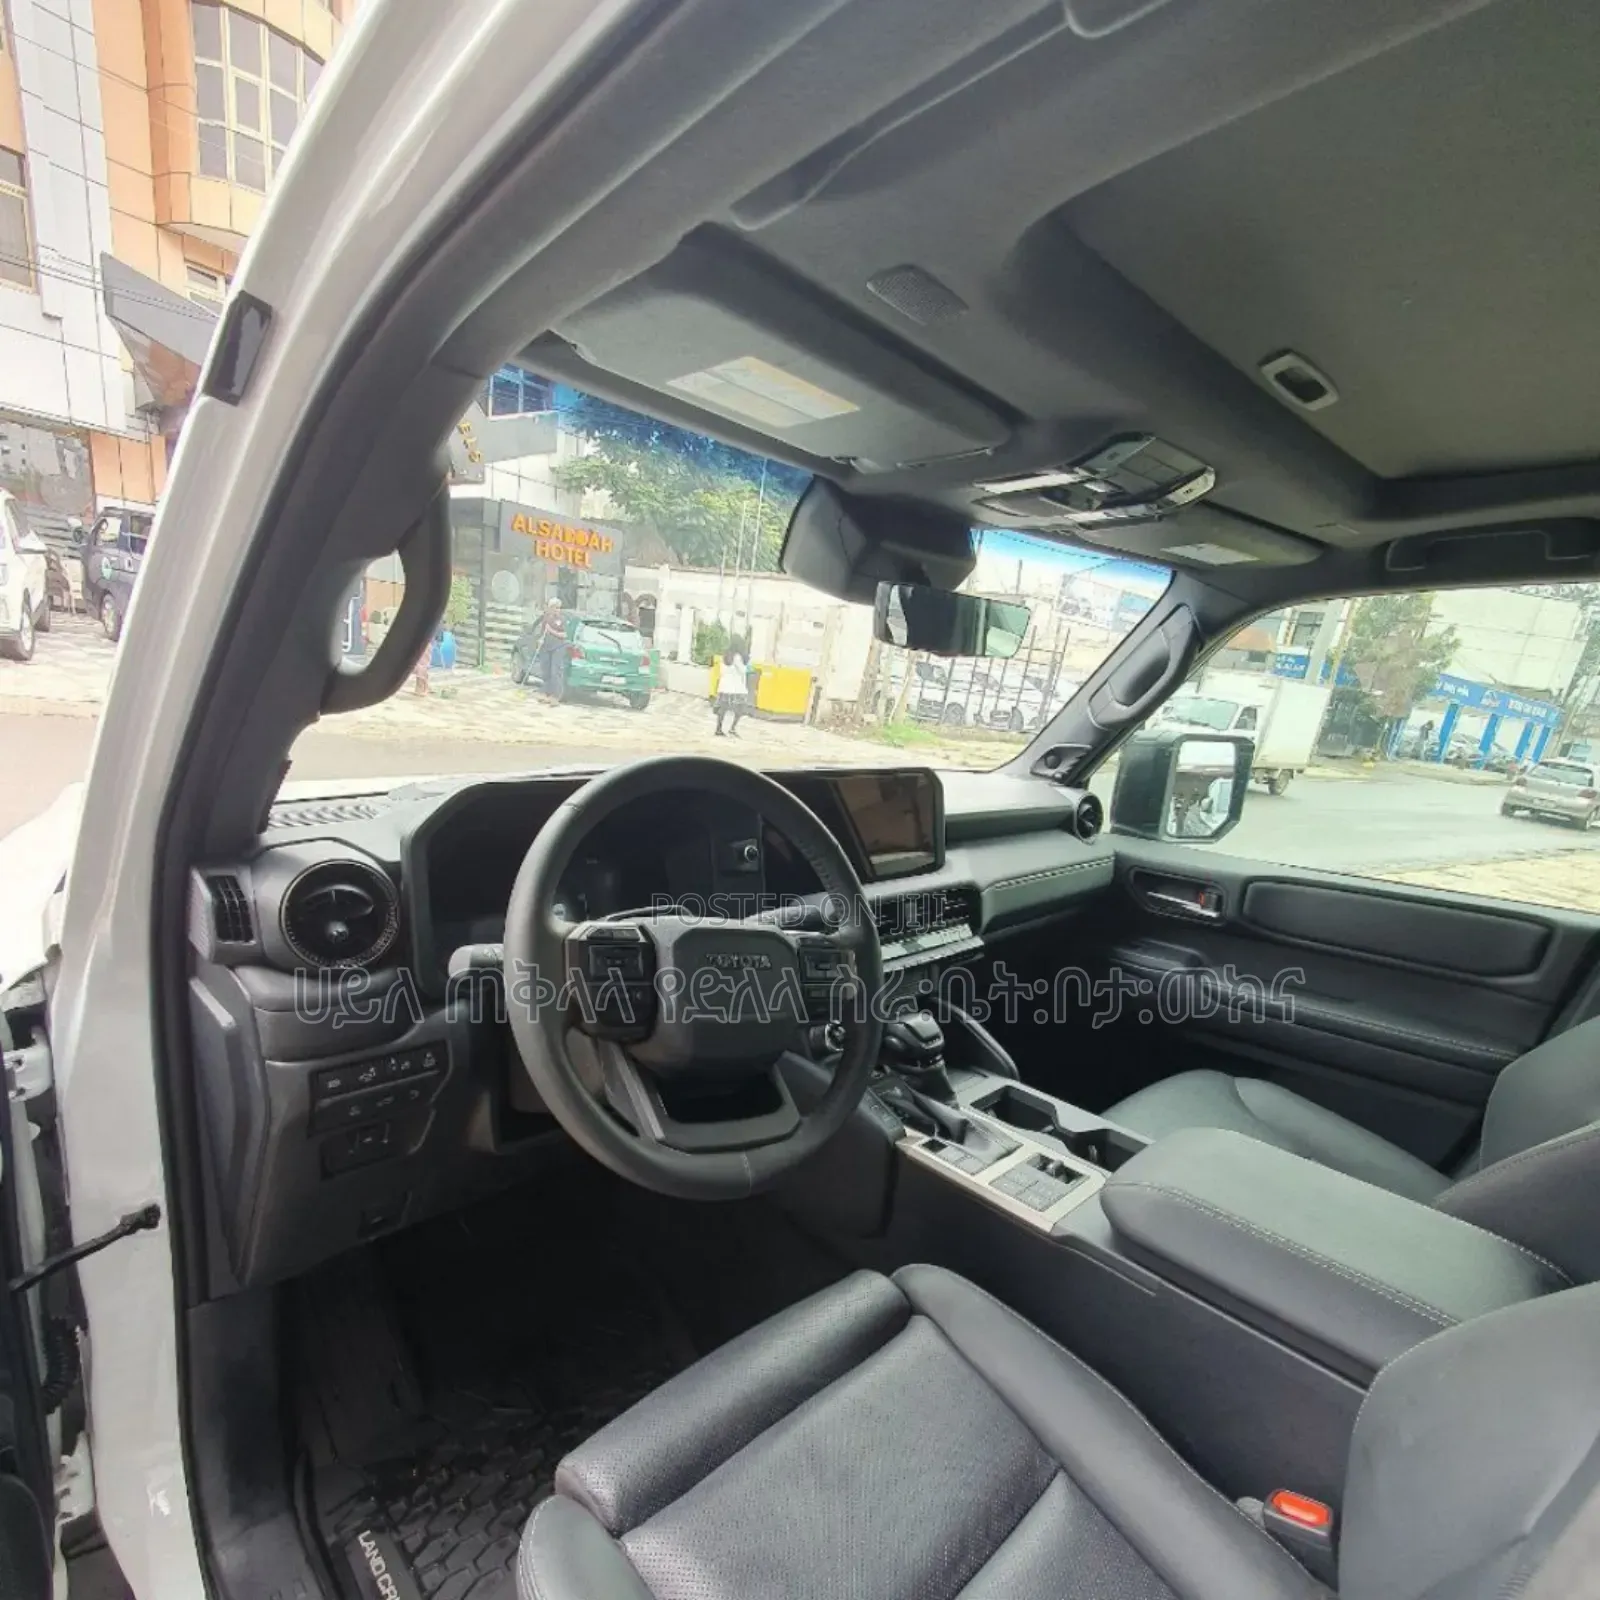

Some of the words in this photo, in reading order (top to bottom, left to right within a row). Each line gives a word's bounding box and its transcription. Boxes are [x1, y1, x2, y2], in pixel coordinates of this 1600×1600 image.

[534, 539, 592, 569] HOTEL
[705, 952, 772, 969] TOYOTA
[358, 1530, 386, 1577] LAND
